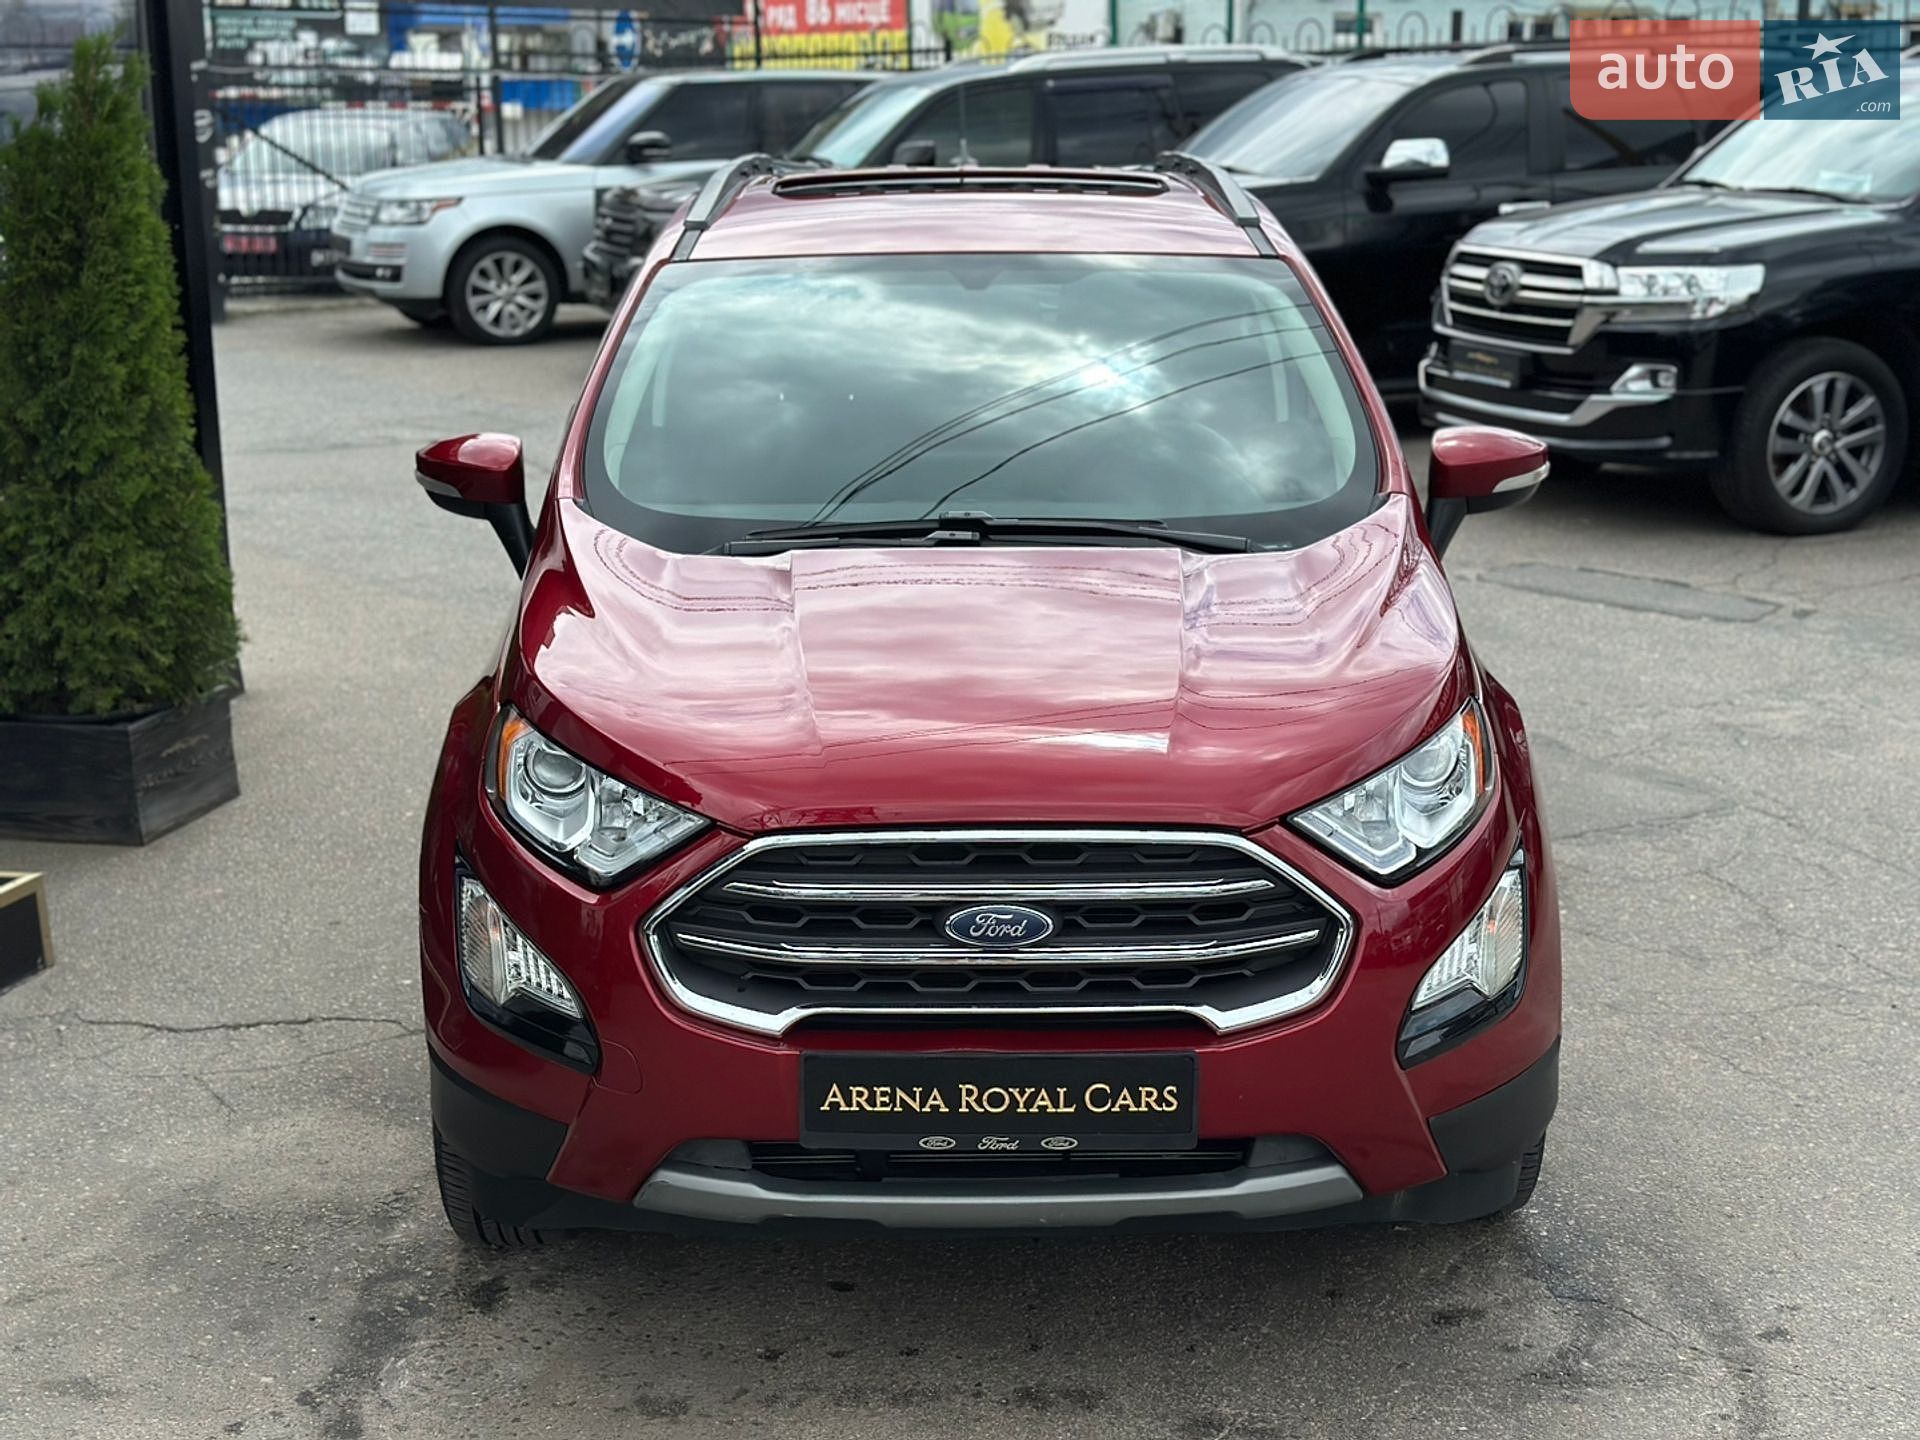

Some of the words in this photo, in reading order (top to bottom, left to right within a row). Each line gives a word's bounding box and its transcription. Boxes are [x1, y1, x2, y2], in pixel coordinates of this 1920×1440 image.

[969, 913, 1028, 937] Ford
[820, 1083, 949, 1113] ARENA
[958, 1084, 1077, 1113] ROYAL
[1084, 1083, 1179, 1113] CARS
[924, 1137, 951, 1148] Ford
[977, 1136, 1020, 1150] Ford
[1046, 1137, 1073, 1148] Ford
